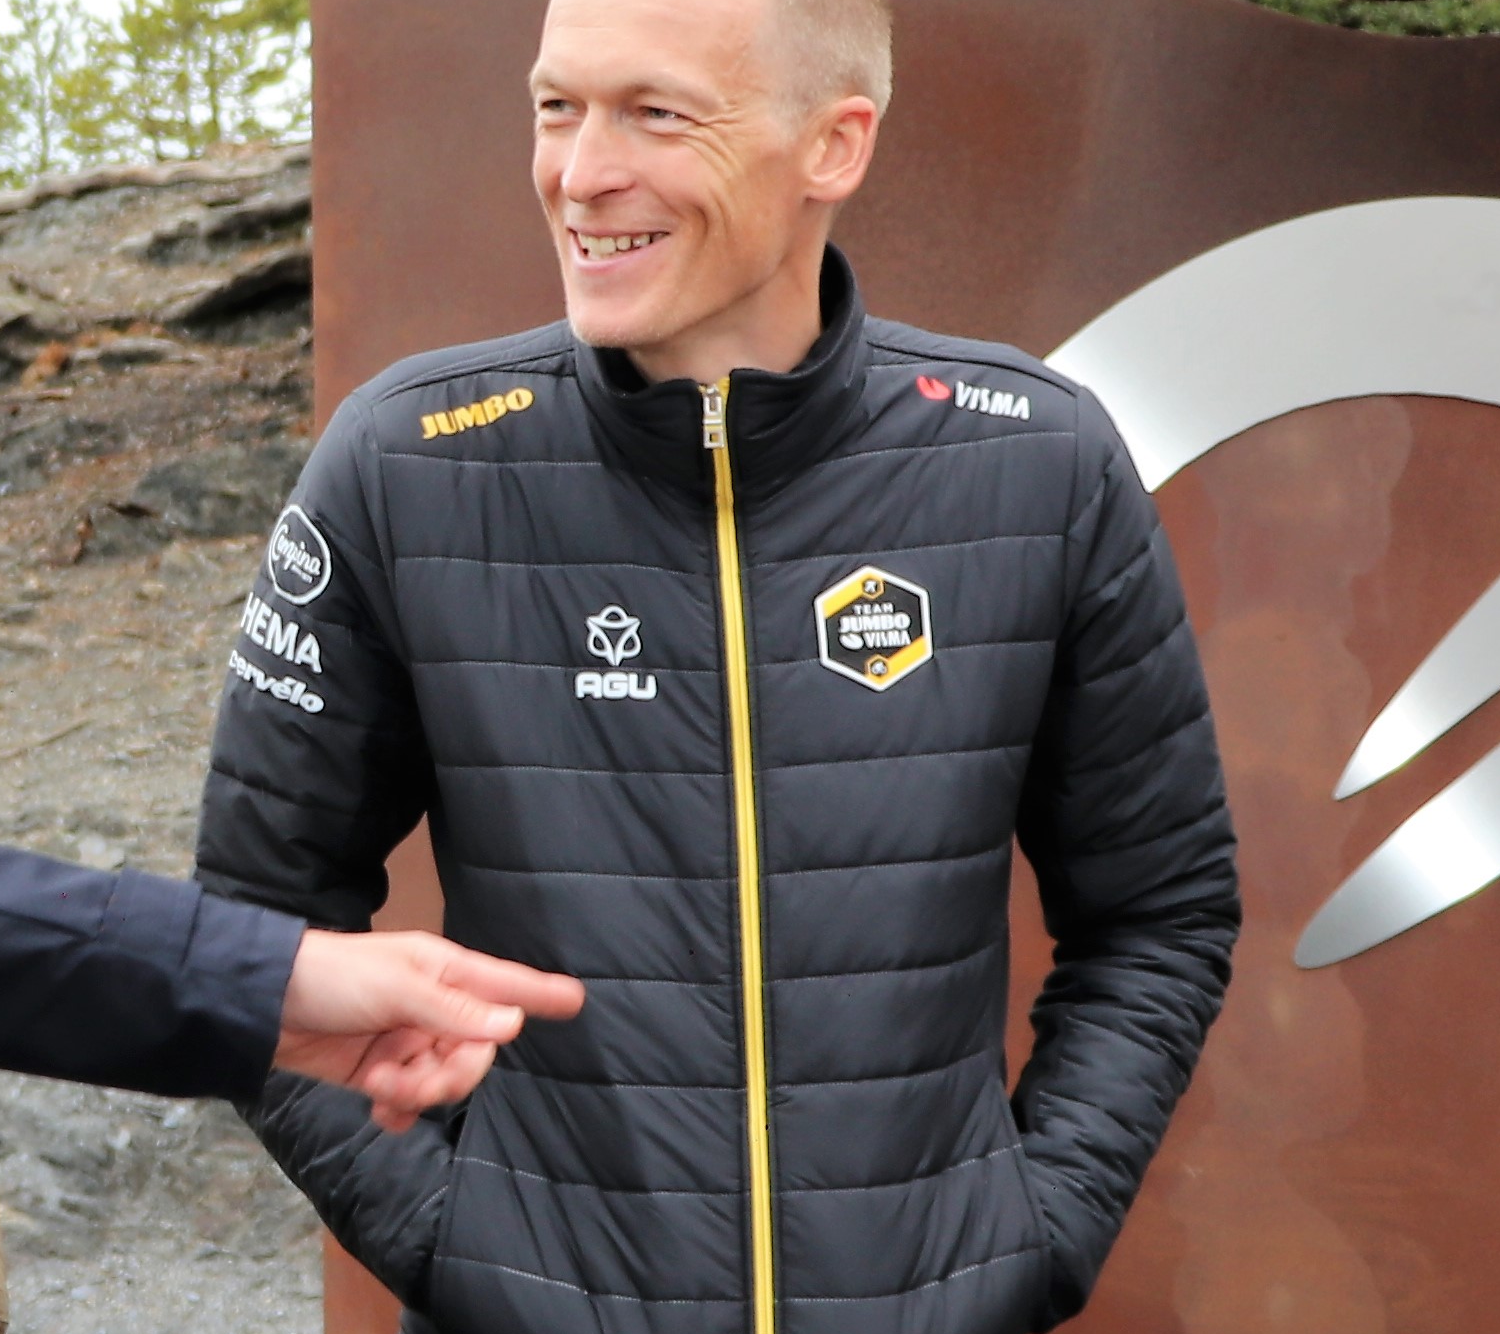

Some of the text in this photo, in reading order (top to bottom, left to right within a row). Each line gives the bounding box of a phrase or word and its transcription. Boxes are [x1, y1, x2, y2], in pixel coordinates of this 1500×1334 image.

[421, 386, 534, 440] JUMBO
[954, 379, 1031, 421] VISMA
[839, 611, 912, 634] JUMBO
[852, 602, 895, 616] TEAM
[240, 591, 323, 674] HEMA
[863, 630, 912, 649] VISMA
[229, 650, 325, 714] cervélo
[575, 670, 658, 701] AGU
